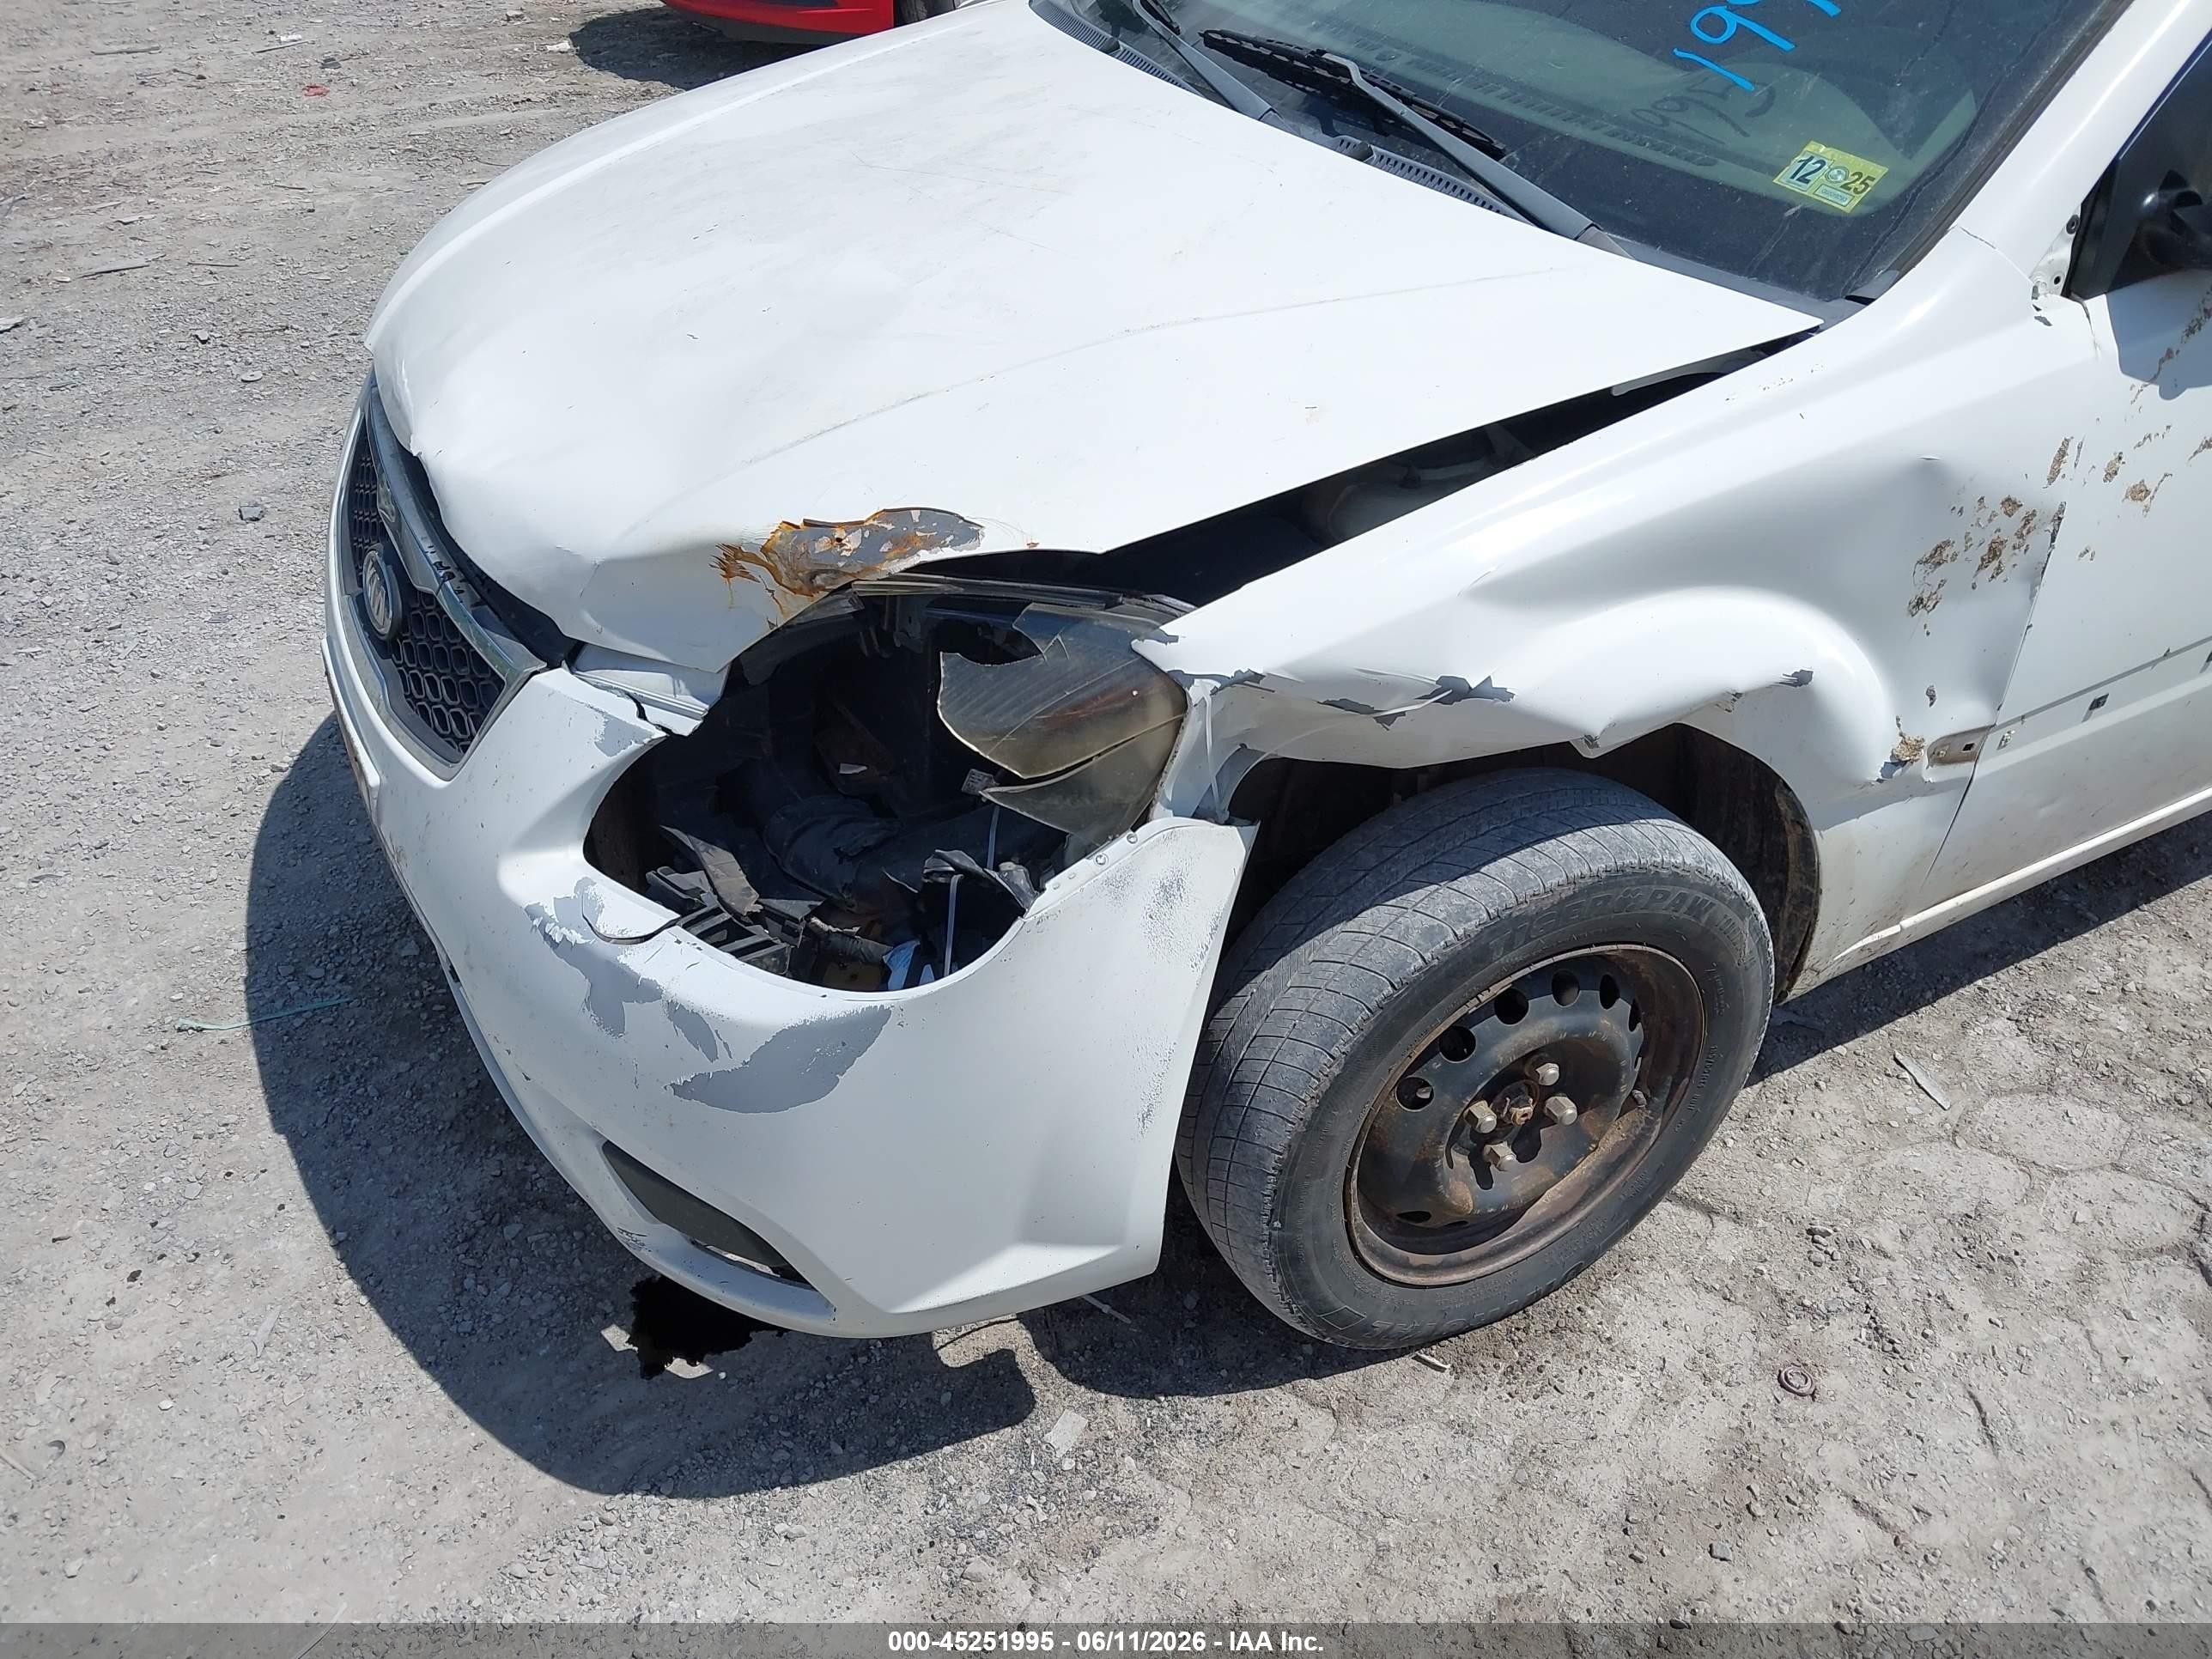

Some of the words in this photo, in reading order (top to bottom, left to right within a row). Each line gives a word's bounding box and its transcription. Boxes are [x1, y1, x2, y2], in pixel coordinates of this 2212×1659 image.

[1673, 0, 1843, 92] 19
[1789, 155, 1826, 185] 12
[1840, 171, 1876, 195] 25
[1639, 887, 1717, 926] PAW
